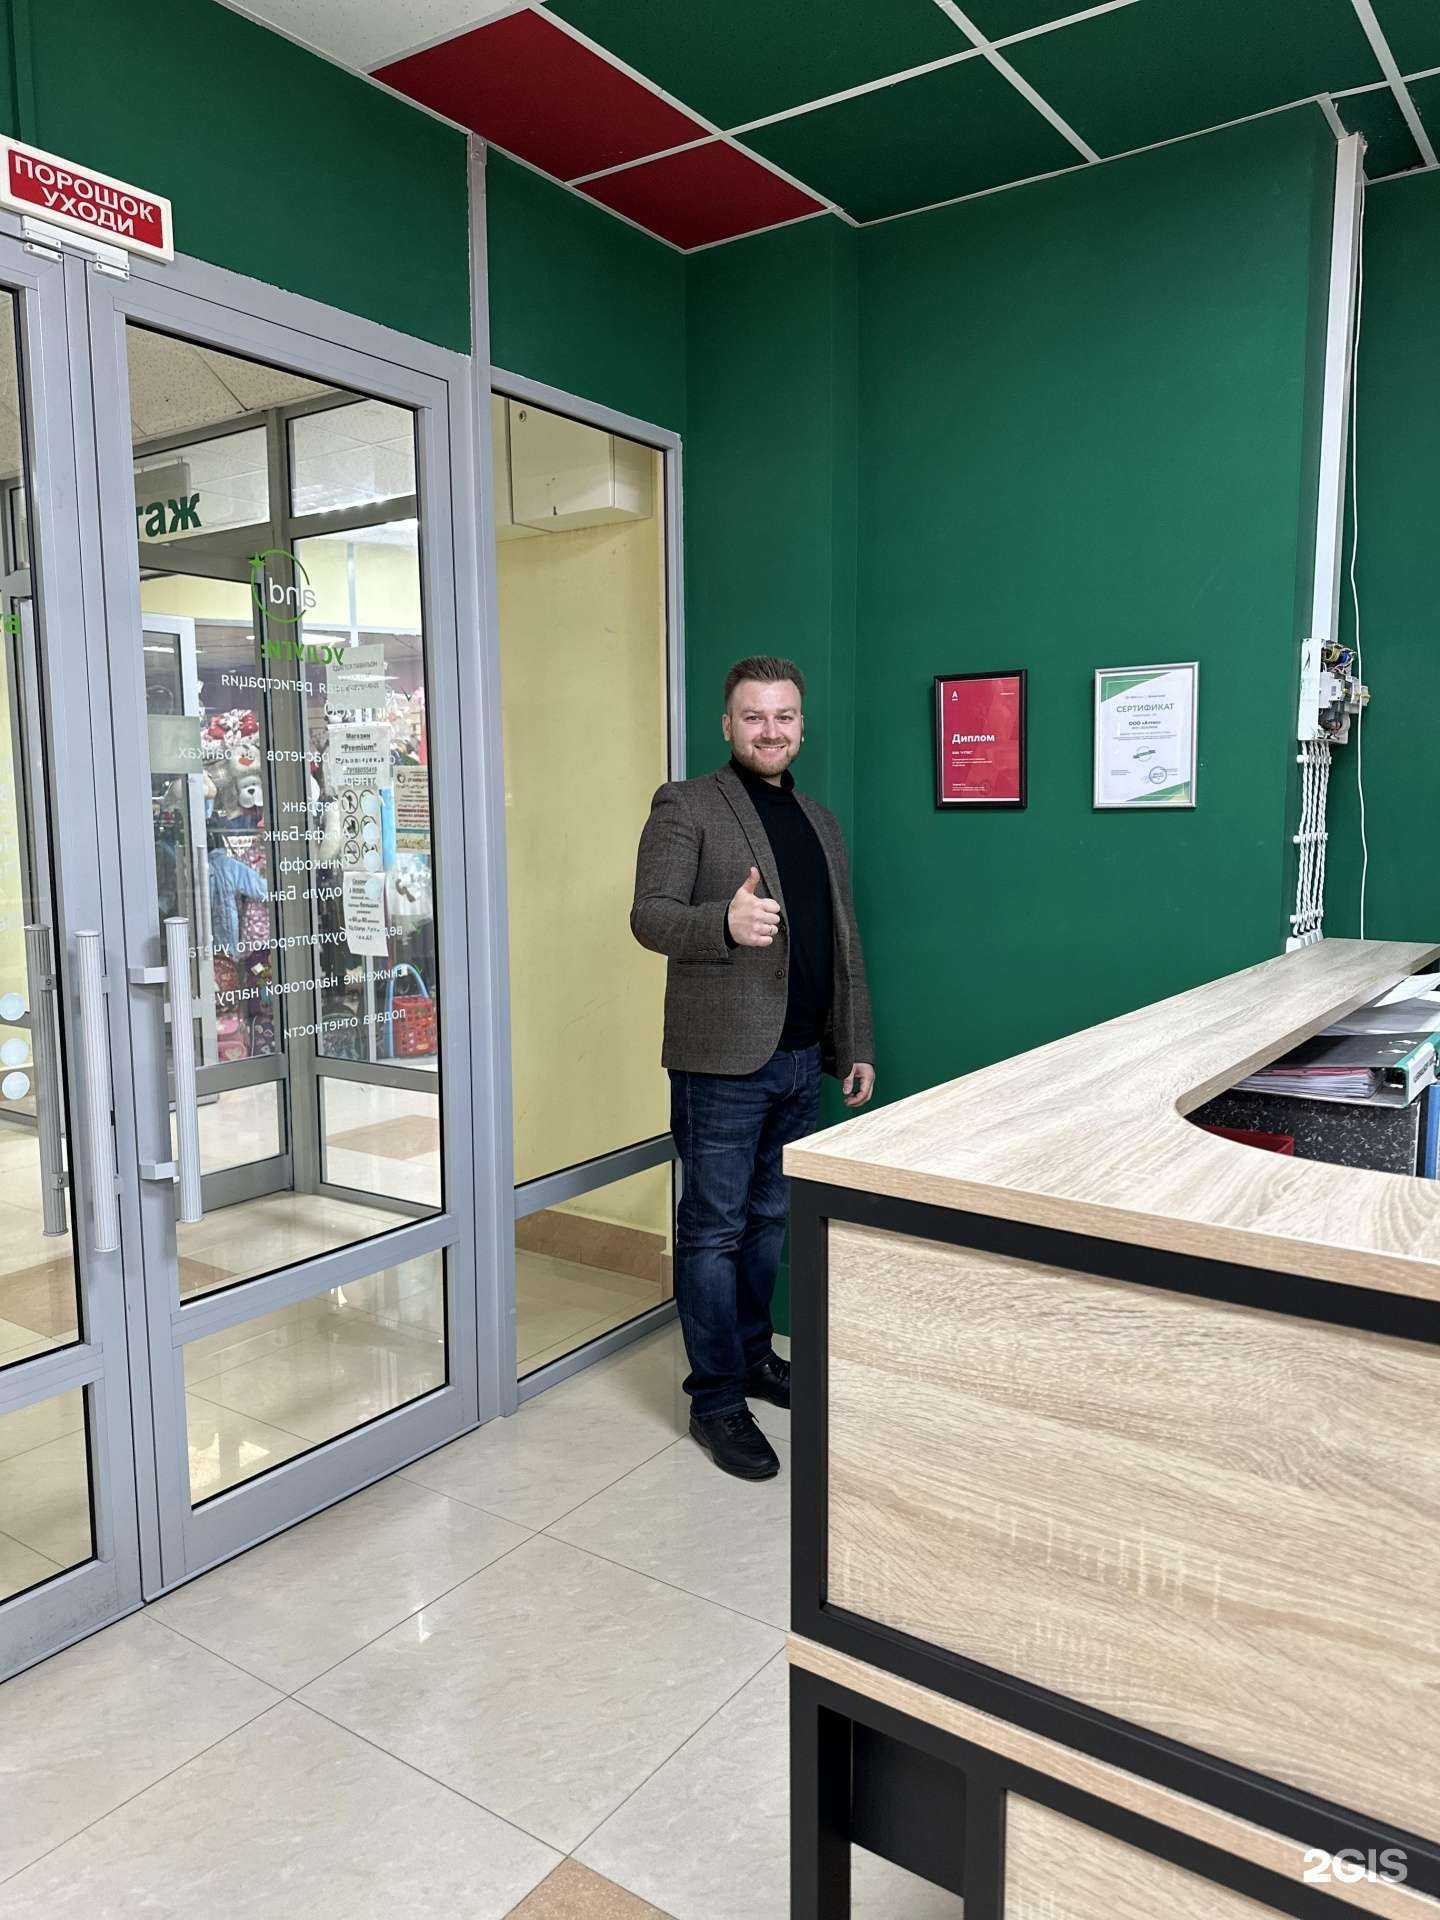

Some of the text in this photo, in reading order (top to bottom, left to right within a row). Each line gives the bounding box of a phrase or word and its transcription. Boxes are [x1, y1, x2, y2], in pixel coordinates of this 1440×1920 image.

[15, 155, 154, 223] ПОРОШОК
[41, 187, 134, 235] УХОДИ
[1117, 703, 1175, 713] СЕРТИФИКАТ
[952, 734, 995, 745] Диплом
